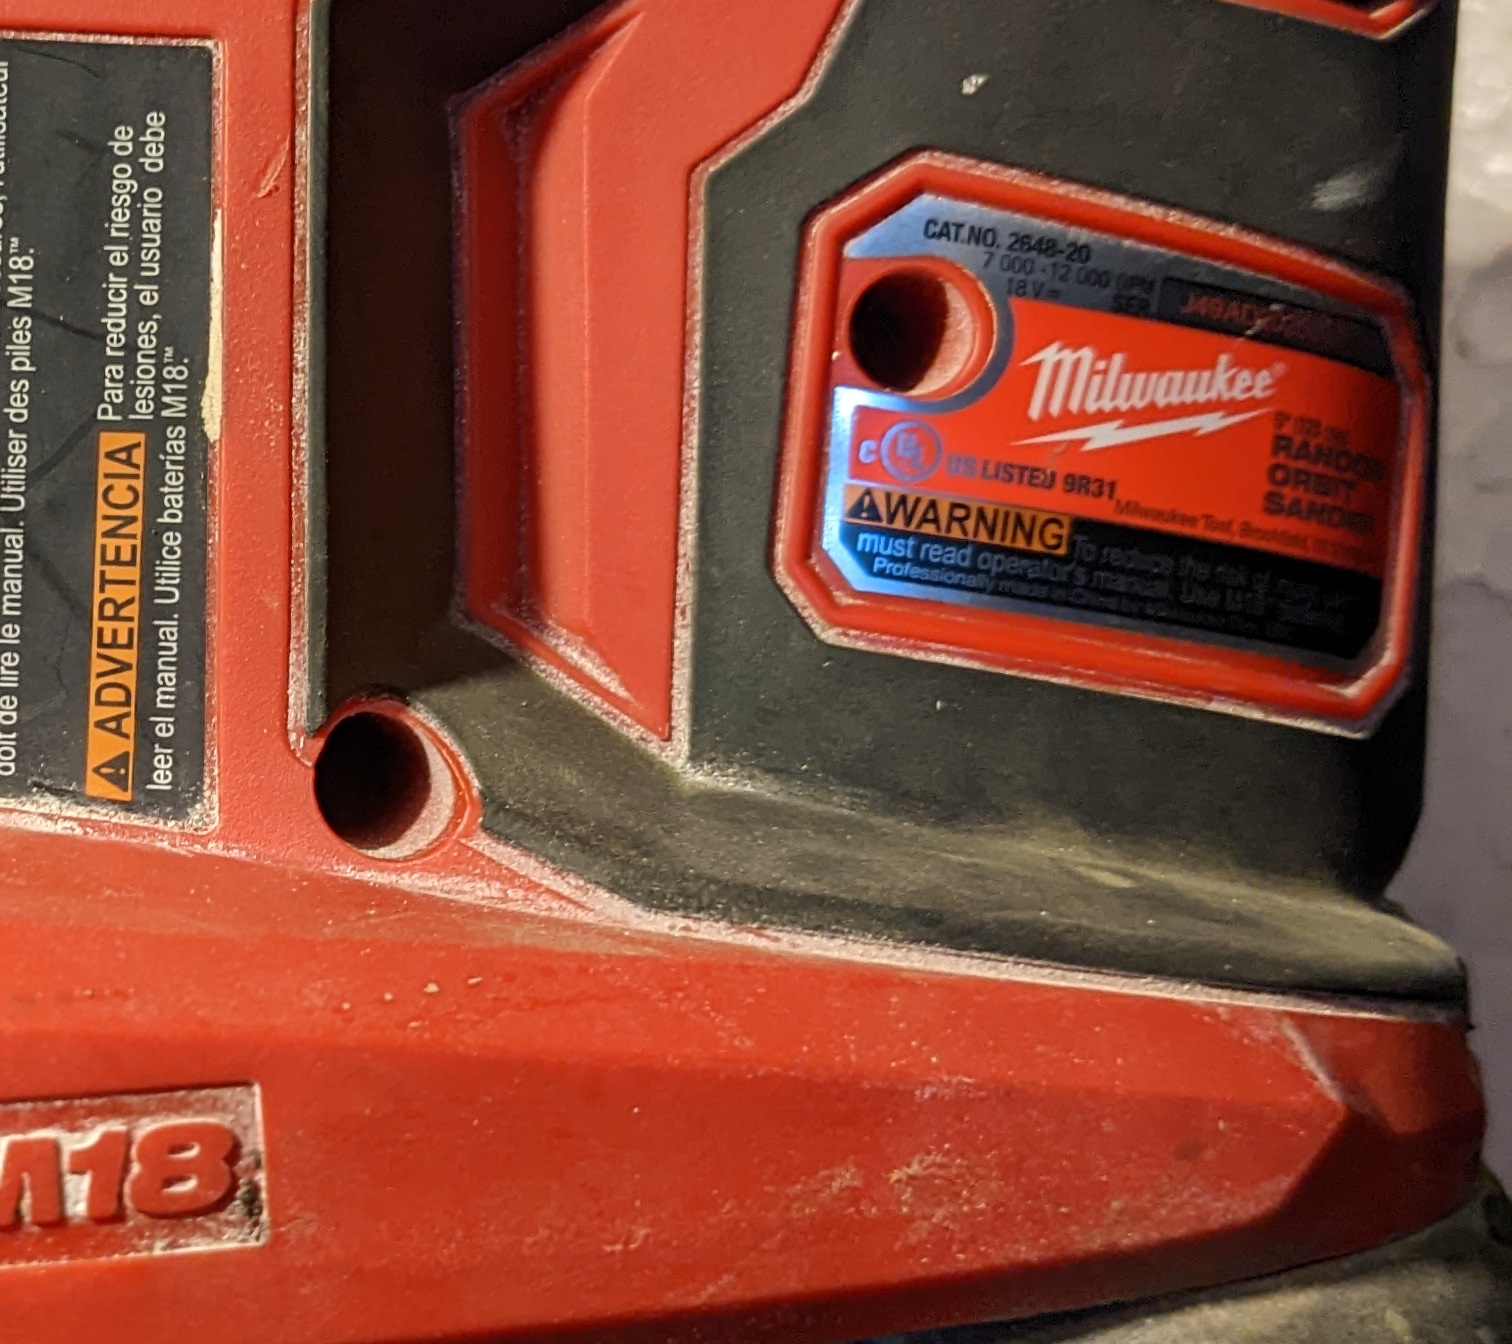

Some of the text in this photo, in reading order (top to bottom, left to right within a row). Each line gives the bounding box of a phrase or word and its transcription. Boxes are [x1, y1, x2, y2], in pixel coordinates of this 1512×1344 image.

[97, 125, 138, 421] Para reducir el riesgo de
[129, 111, 166, 420] lesiones, el usuario debe
[1007, 232, 1092, 265] 2648-20
[7, 316, 36, 371] piles
[4, 379, 30, 423] des
[1018, 340, 1277, 421] Milwaukee
[0, 429, 29, 512] Utiliser
[157, 425, 186, 523] baterías
[980, 459, 1057, 490] LISTED
[1063, 473, 1117, 501] 9R31
[1271, 434, 1387, 482] RAND
[884, 490, 1065, 551] WARNING
[1262, 490, 1376, 536] SAND
[153, 530, 182, 604] Utilice
[856, 531, 915, 559] must
[920, 542, 972, 567] read
[873, 556, 996, 593] Professionally
[94, 441, 141, 740] ADVERTENCIA
[152, 613, 180, 709] manual.
[149, 717, 176, 737] el
[145, 743, 174, 790] leer
